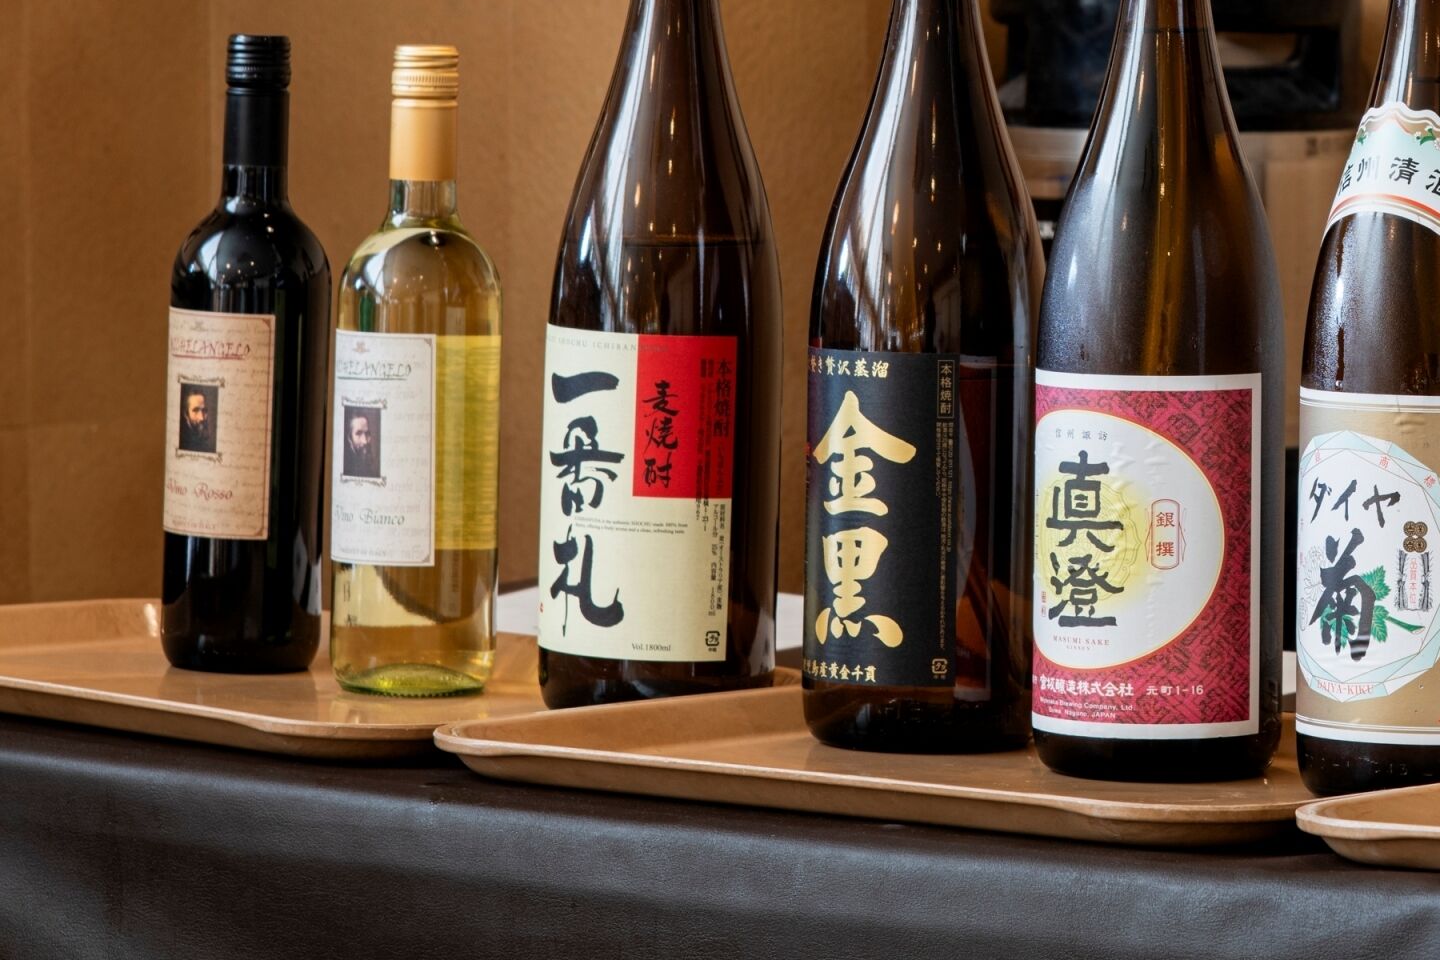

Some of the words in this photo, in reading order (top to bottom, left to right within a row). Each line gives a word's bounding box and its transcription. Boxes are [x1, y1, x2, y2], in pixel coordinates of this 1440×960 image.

[939, 362, 953, 415] 本格焼酎
[194, 482, 234, 501] Rosso
[359, 507, 406, 526] Bianco
[1308, 476, 1401, 529] ダイヤ
[812, 390, 917, 649] 金黒
[1155, 511, 1176, 557] 銀撰
[1308, 527, 1377, 663] 菊
